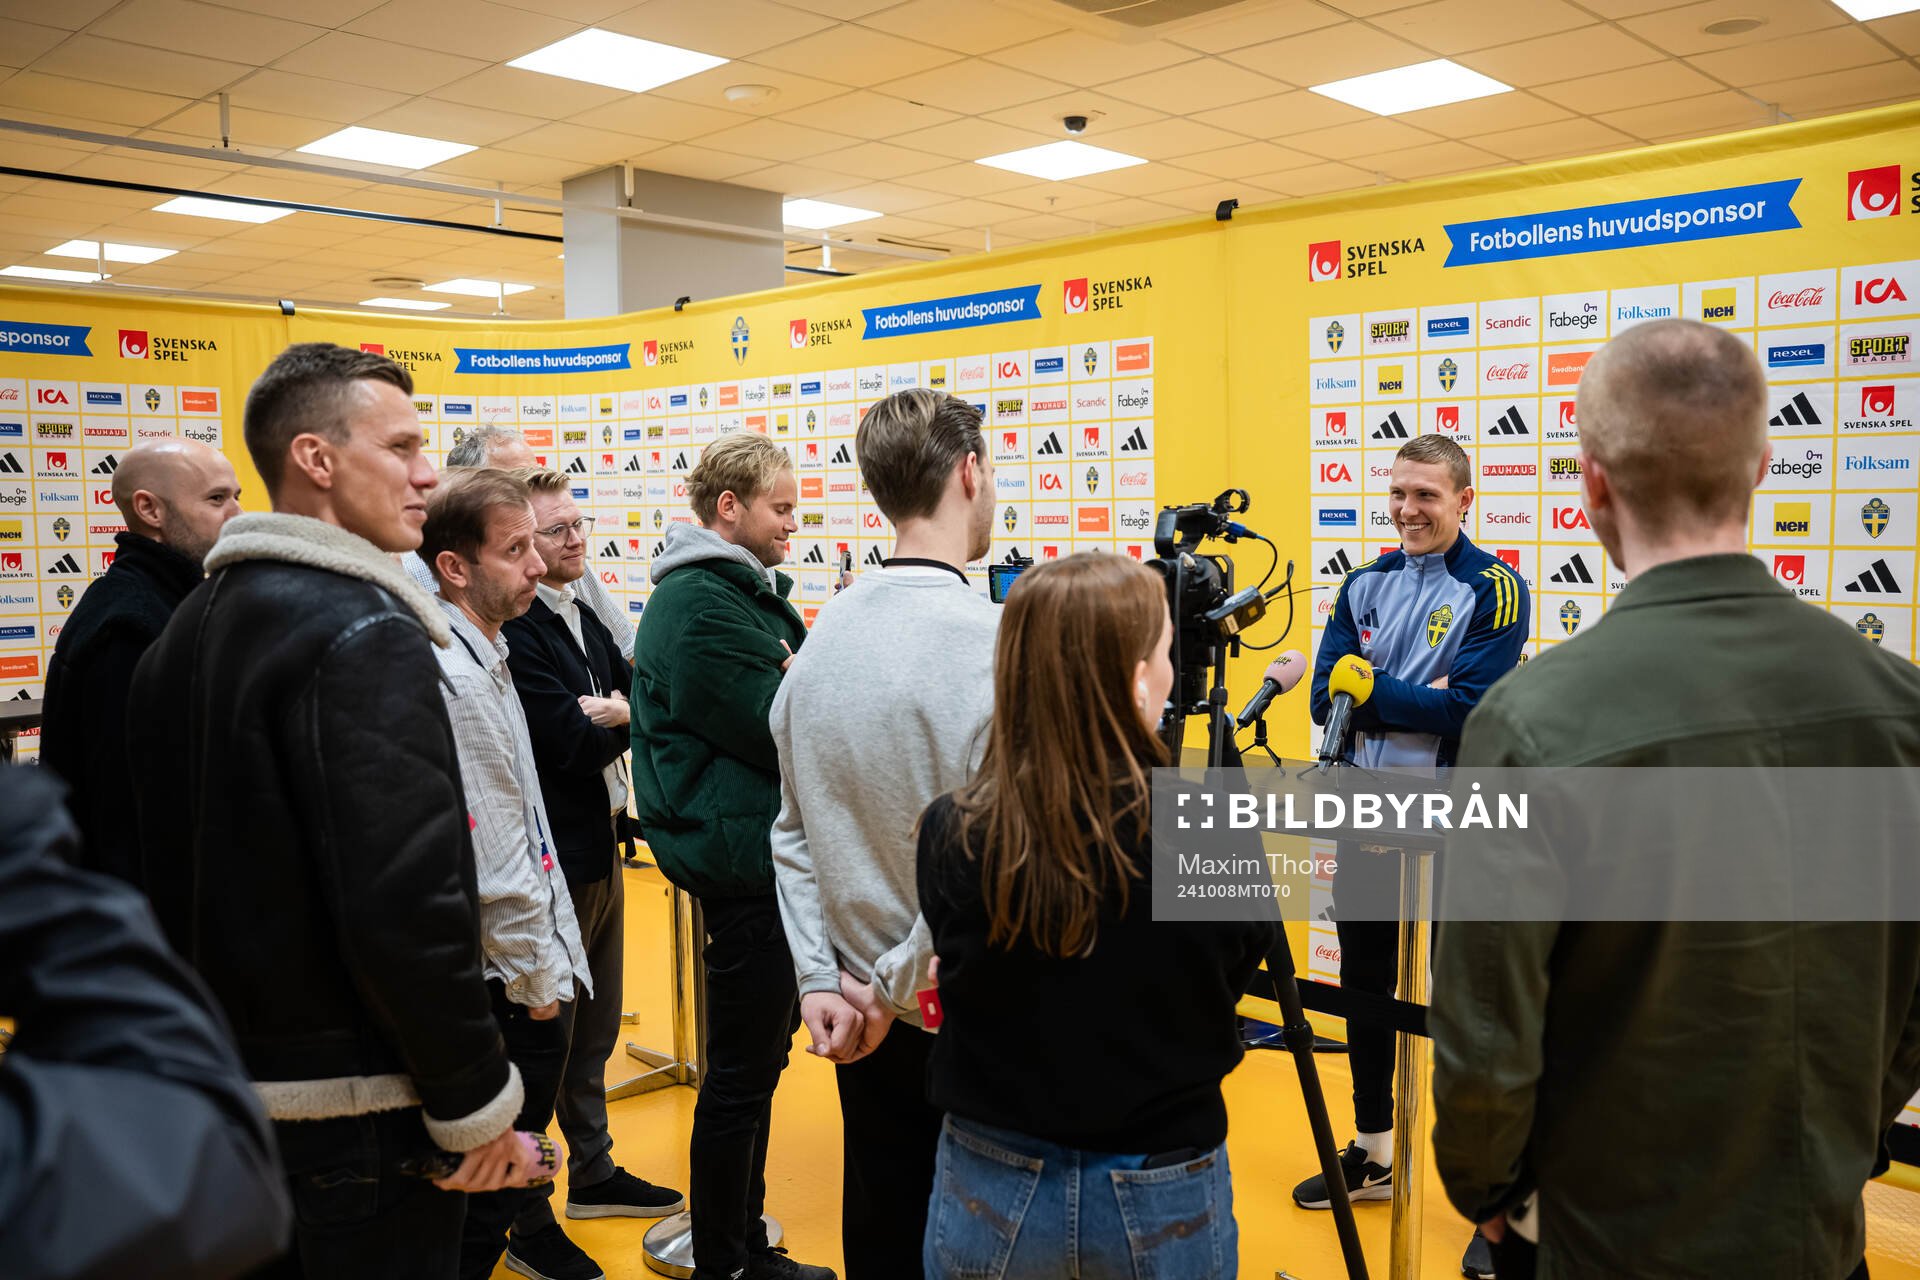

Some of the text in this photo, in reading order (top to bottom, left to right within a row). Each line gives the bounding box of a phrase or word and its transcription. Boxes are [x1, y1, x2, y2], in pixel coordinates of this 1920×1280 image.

[1470, 200, 1766, 252] Fotbollens huvudsponsor
[1348, 238, 1425, 260] SVENSKA
[1348, 262, 1387, 278] SPEL
[1093, 276, 1152, 296] SVENSKA
[1855, 277, 1907, 305] ICA
[1093, 296, 1123, 311] SPEL
[876, 298, 1025, 330] Fotbollens huvudsponsor
[1618, 305, 1670, 320] Folksam
[811, 319, 852, 334] SVENSKA
[1486, 316, 1531, 329] Scandic
[1550, 312, 1597, 329] Fabege
[1370, 320, 1409, 338] SPORT
[154, 338, 217, 351] SVENSKA
[660, 340, 694, 353] SVENSKA
[811, 336, 832, 346] SPEL
[1850, 336, 1909, 357] SPORT
[154, 350, 188, 361] SPEL
[389, 350, 442, 361] SVENSKA
[471, 352, 621, 368] Fotbollens huvudsponsor
[660, 355, 678, 364] SPEL
[1853, 355, 1906, 363] BLADET
[400, 363, 416, 371] PEL
[998, 362, 1021, 378] ICA
[1316, 378, 1356, 390] Folksam
[38, 389, 69, 404] ICA
[648, 396, 661, 409] ICA
[1077, 398, 1106, 408] Scandic
[1118, 395, 1148, 408] Fabege
[523, 406, 551, 416] Fabege
[997, 400, 1022, 412] SPORT
[1032, 401, 1066, 411] BAUHAUS
[37, 423, 72, 434] SPORT
[1844, 420, 1912, 429] SVENSKA SPEL
[138, 429, 172, 438] Scandic
[186, 430, 217, 442] Fabege
[1845, 456, 1910, 470] Folksam
[1320, 463, 1352, 482] ICA
[1482, 464, 1536, 476] BAUHAUS
[997, 478, 1025, 488] Folksam
[1040, 474, 1062, 490] ICA
[40, 492, 79, 501] Folksam
[94, 490, 114, 504] IC
[864, 513, 882, 528] ICA
[1034, 516, 1068, 524] BAUHAUS
[1121, 515, 1150, 530] Fabege
[1372, 512, 1394, 525] Fabe
[1486, 512, 1532, 524] Scandic
[1553, 507, 1591, 530] ICA
[600, 572, 618, 584] ICA
